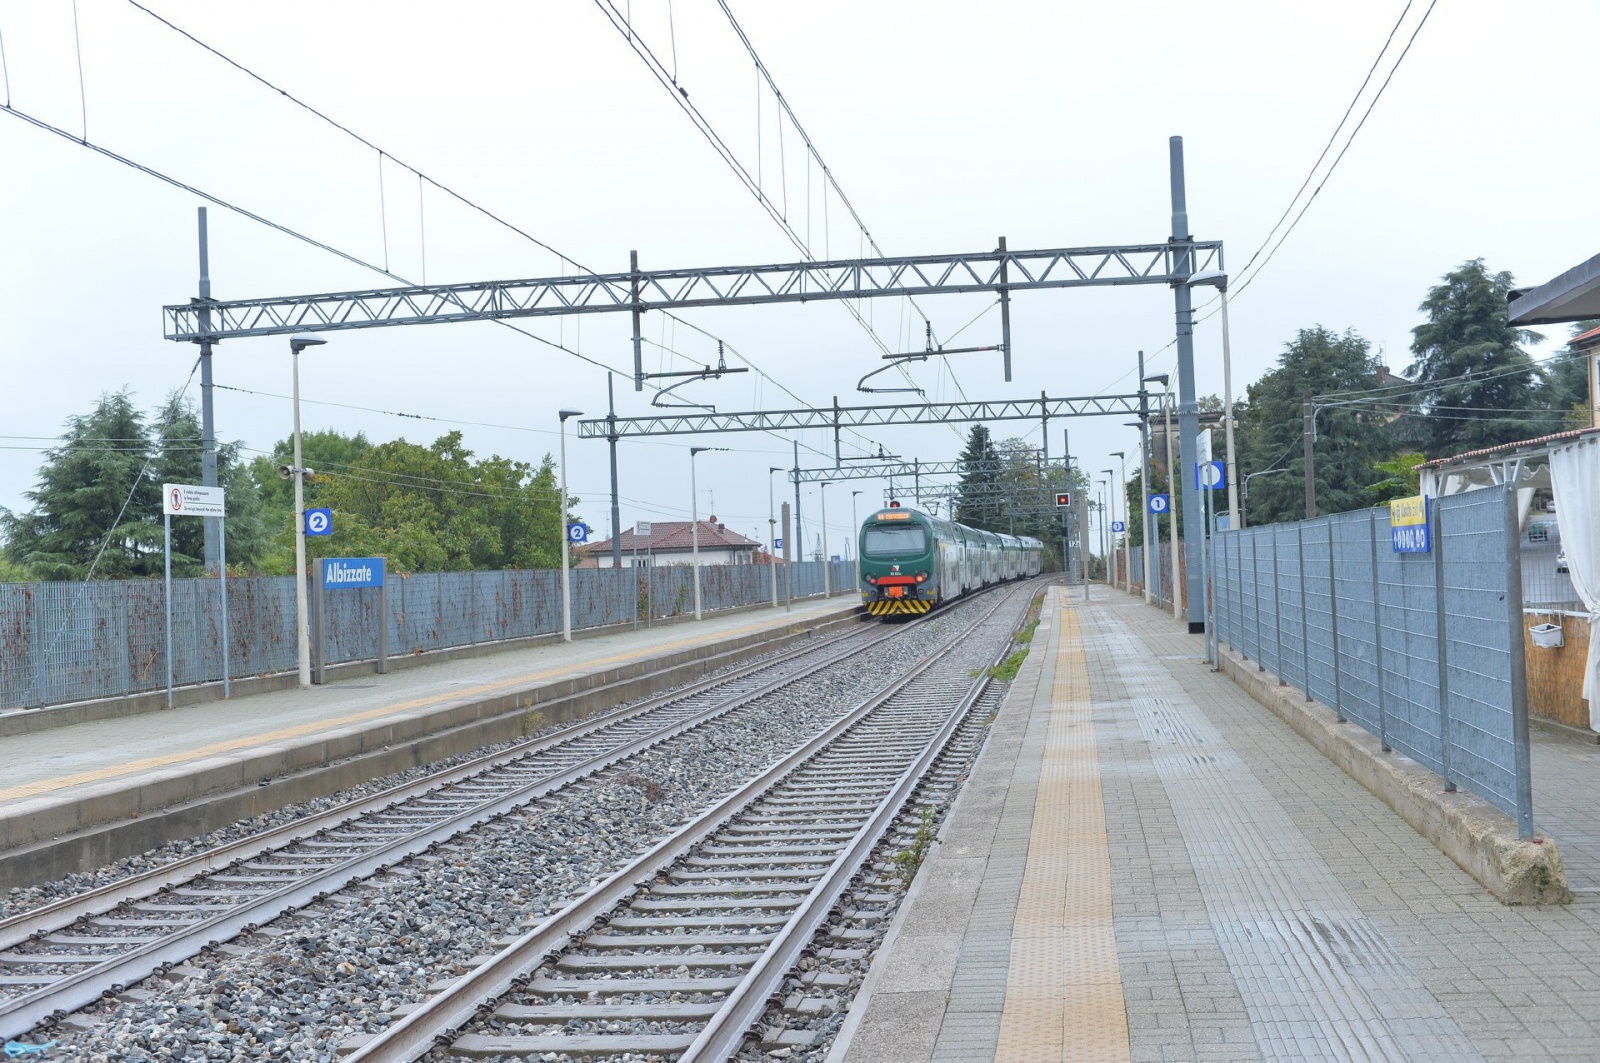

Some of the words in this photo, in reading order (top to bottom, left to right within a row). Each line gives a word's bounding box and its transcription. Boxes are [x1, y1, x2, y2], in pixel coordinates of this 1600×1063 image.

[313, 516, 323, 528] 2
[573, 528, 581, 538] 2
[326, 562, 372, 583] Albizzate
